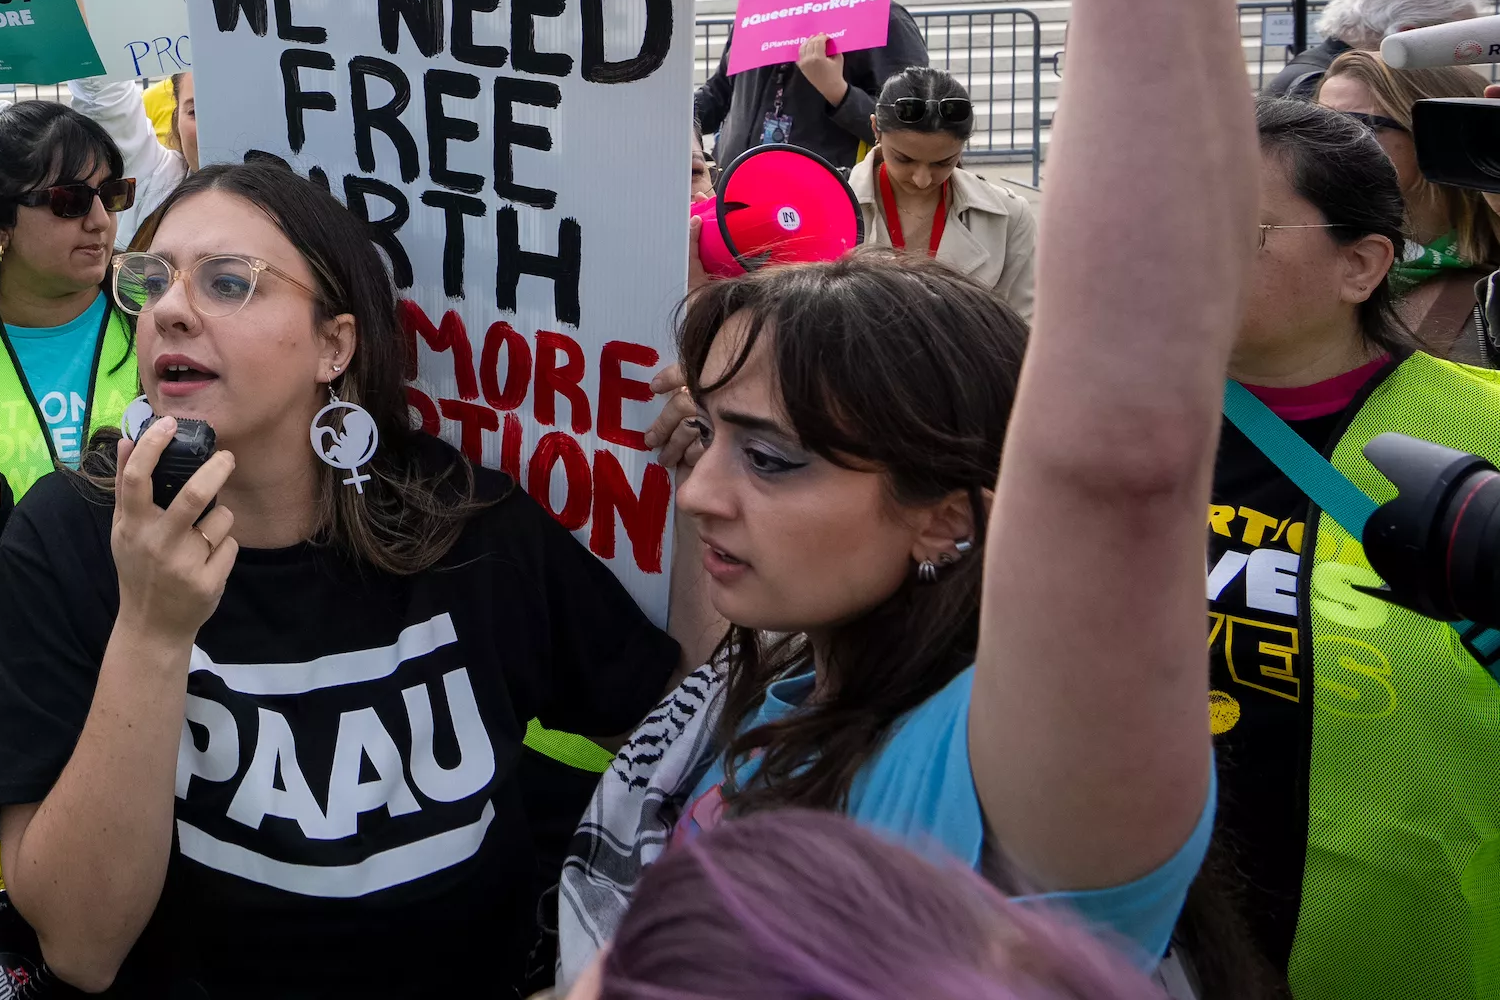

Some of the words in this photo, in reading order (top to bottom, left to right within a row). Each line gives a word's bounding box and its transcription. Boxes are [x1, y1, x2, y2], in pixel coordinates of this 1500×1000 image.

[769, 37, 800, 49] Planned
[279, 48, 562, 210] FREE
[244, 149, 581, 329] RTH
[400, 298, 660, 452] MORE
[175, 667, 496, 840] PAAU
